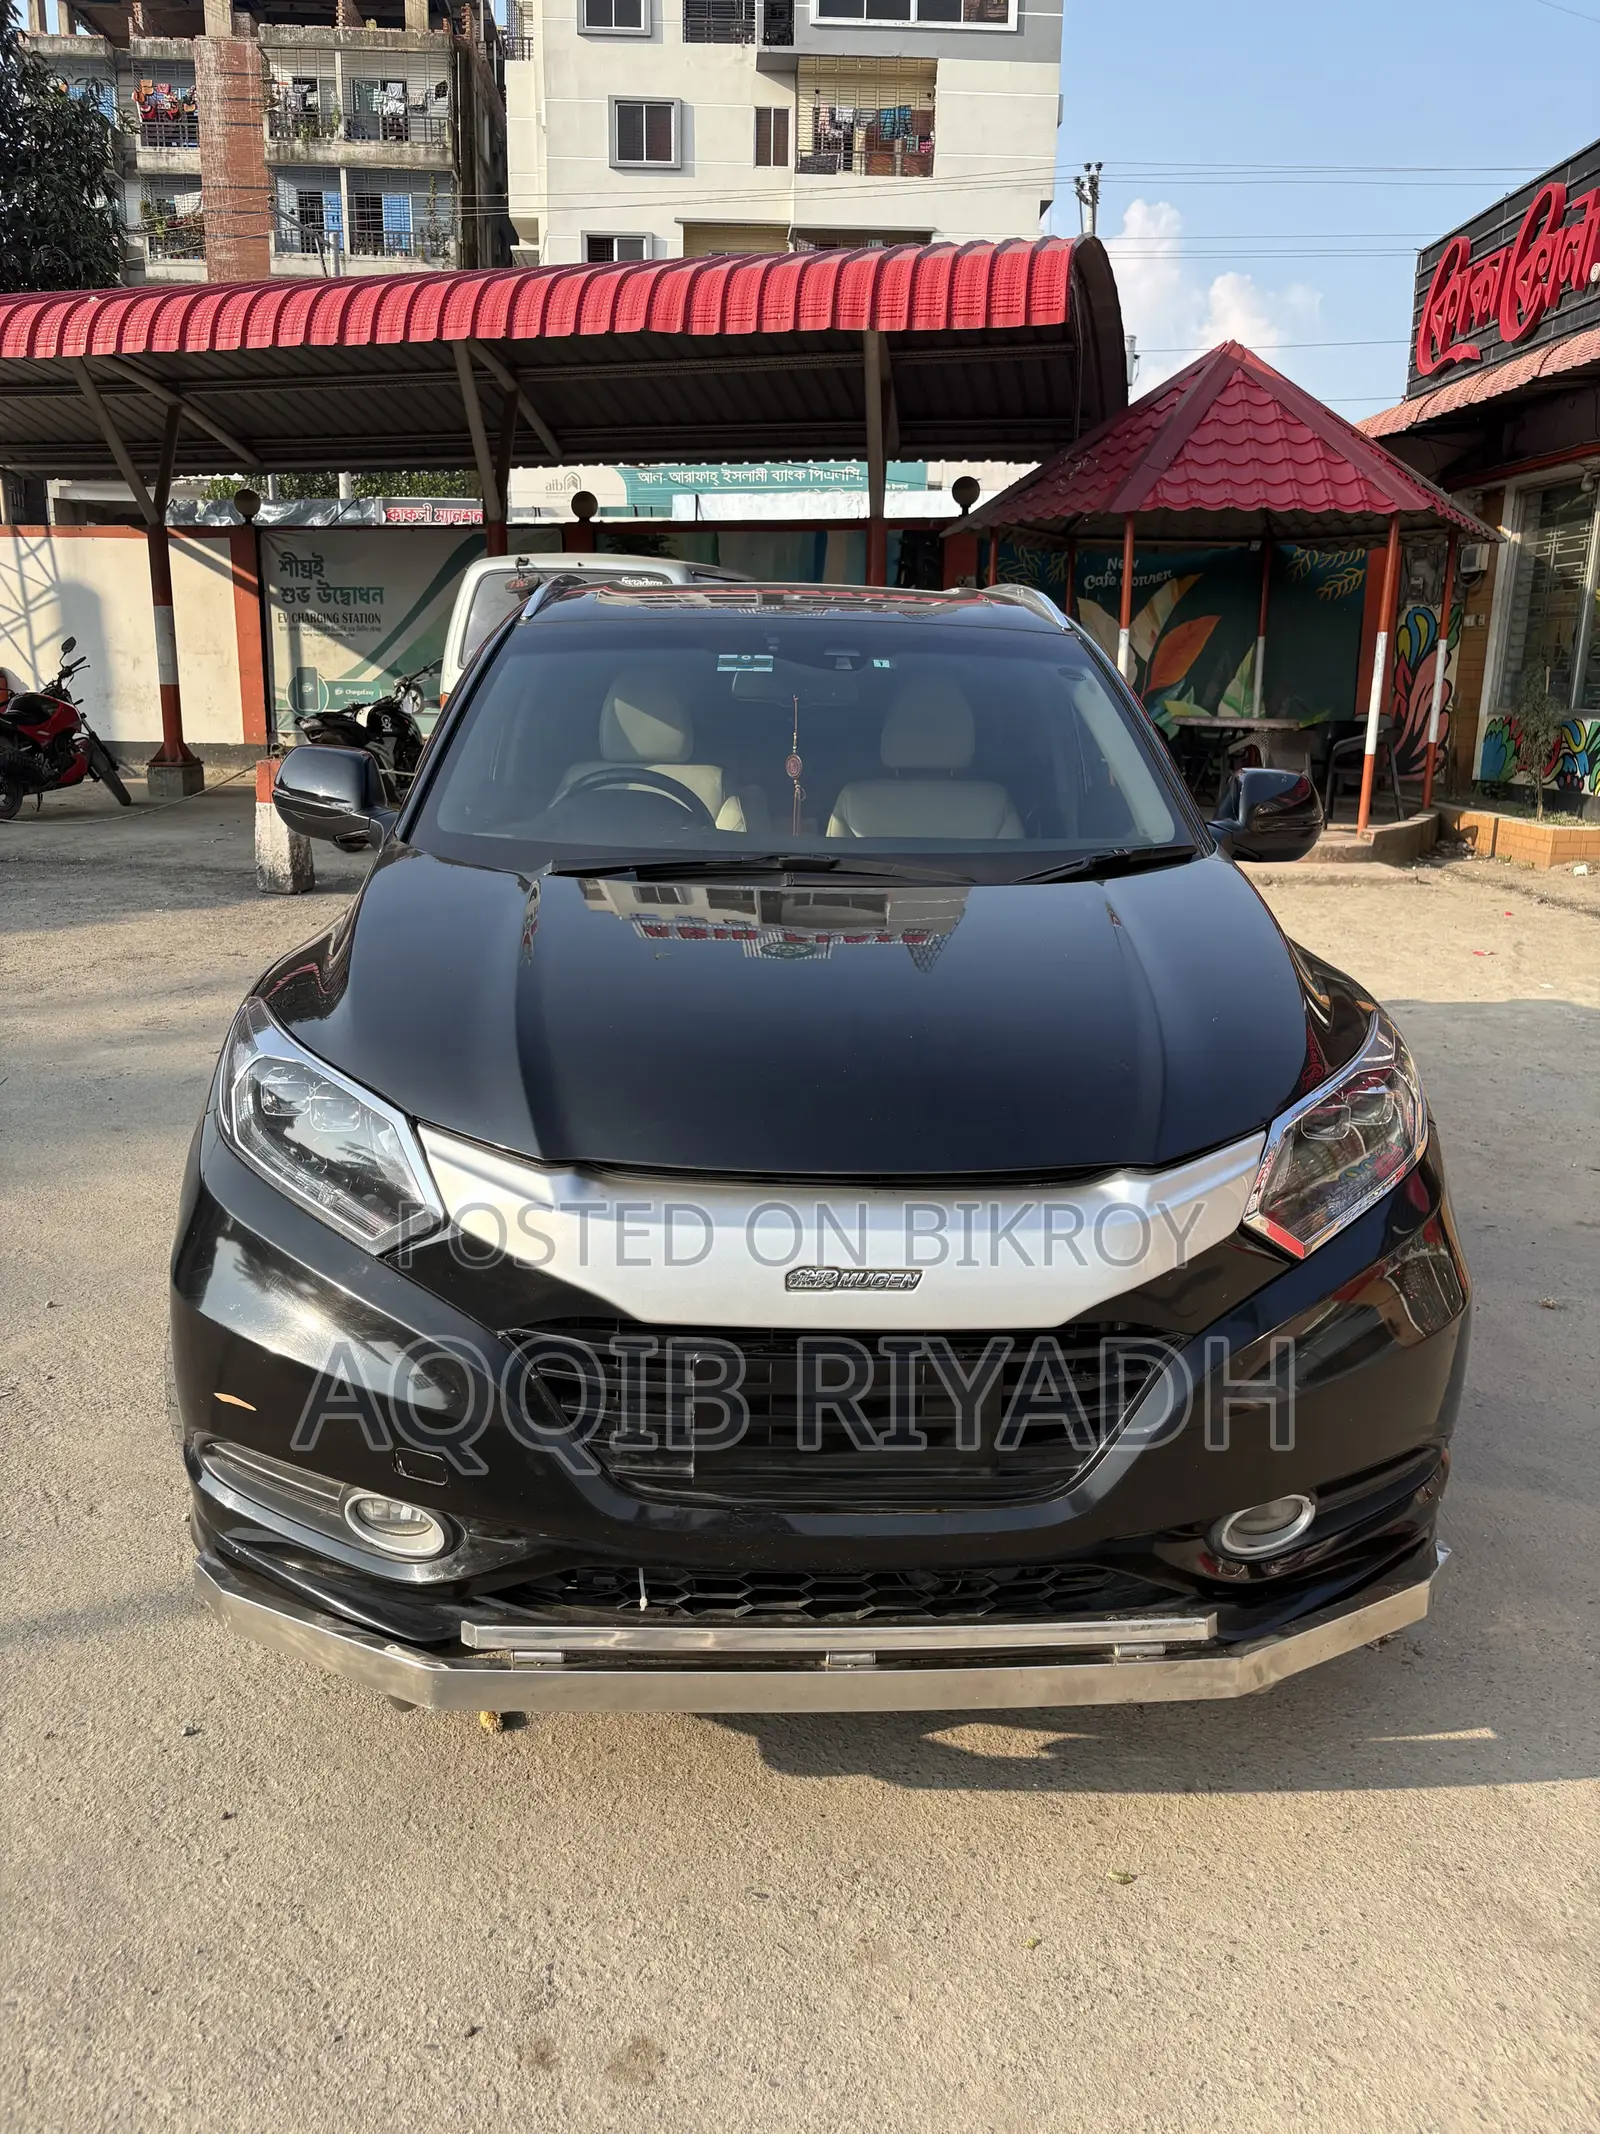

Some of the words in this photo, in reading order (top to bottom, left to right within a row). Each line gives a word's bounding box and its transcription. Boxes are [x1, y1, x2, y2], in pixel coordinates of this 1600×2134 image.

[721, 467, 768, 483] ইসলামী
[771, 468, 807, 482] ব্যাংক
[386, 503, 433, 524] কাকলী
[278, 551, 325, 579] শীঘ্রই
[1084, 571, 1117, 589] Cafe
[280, 586, 311, 604] শুভ
[316, 579, 384, 606] উদ্বোধন
[278, 613, 289, 624] EV
[291, 613, 340, 625] CHARGING
[342, 613, 382, 624] STATION
[838, 1271, 921, 1290] MUGEN
